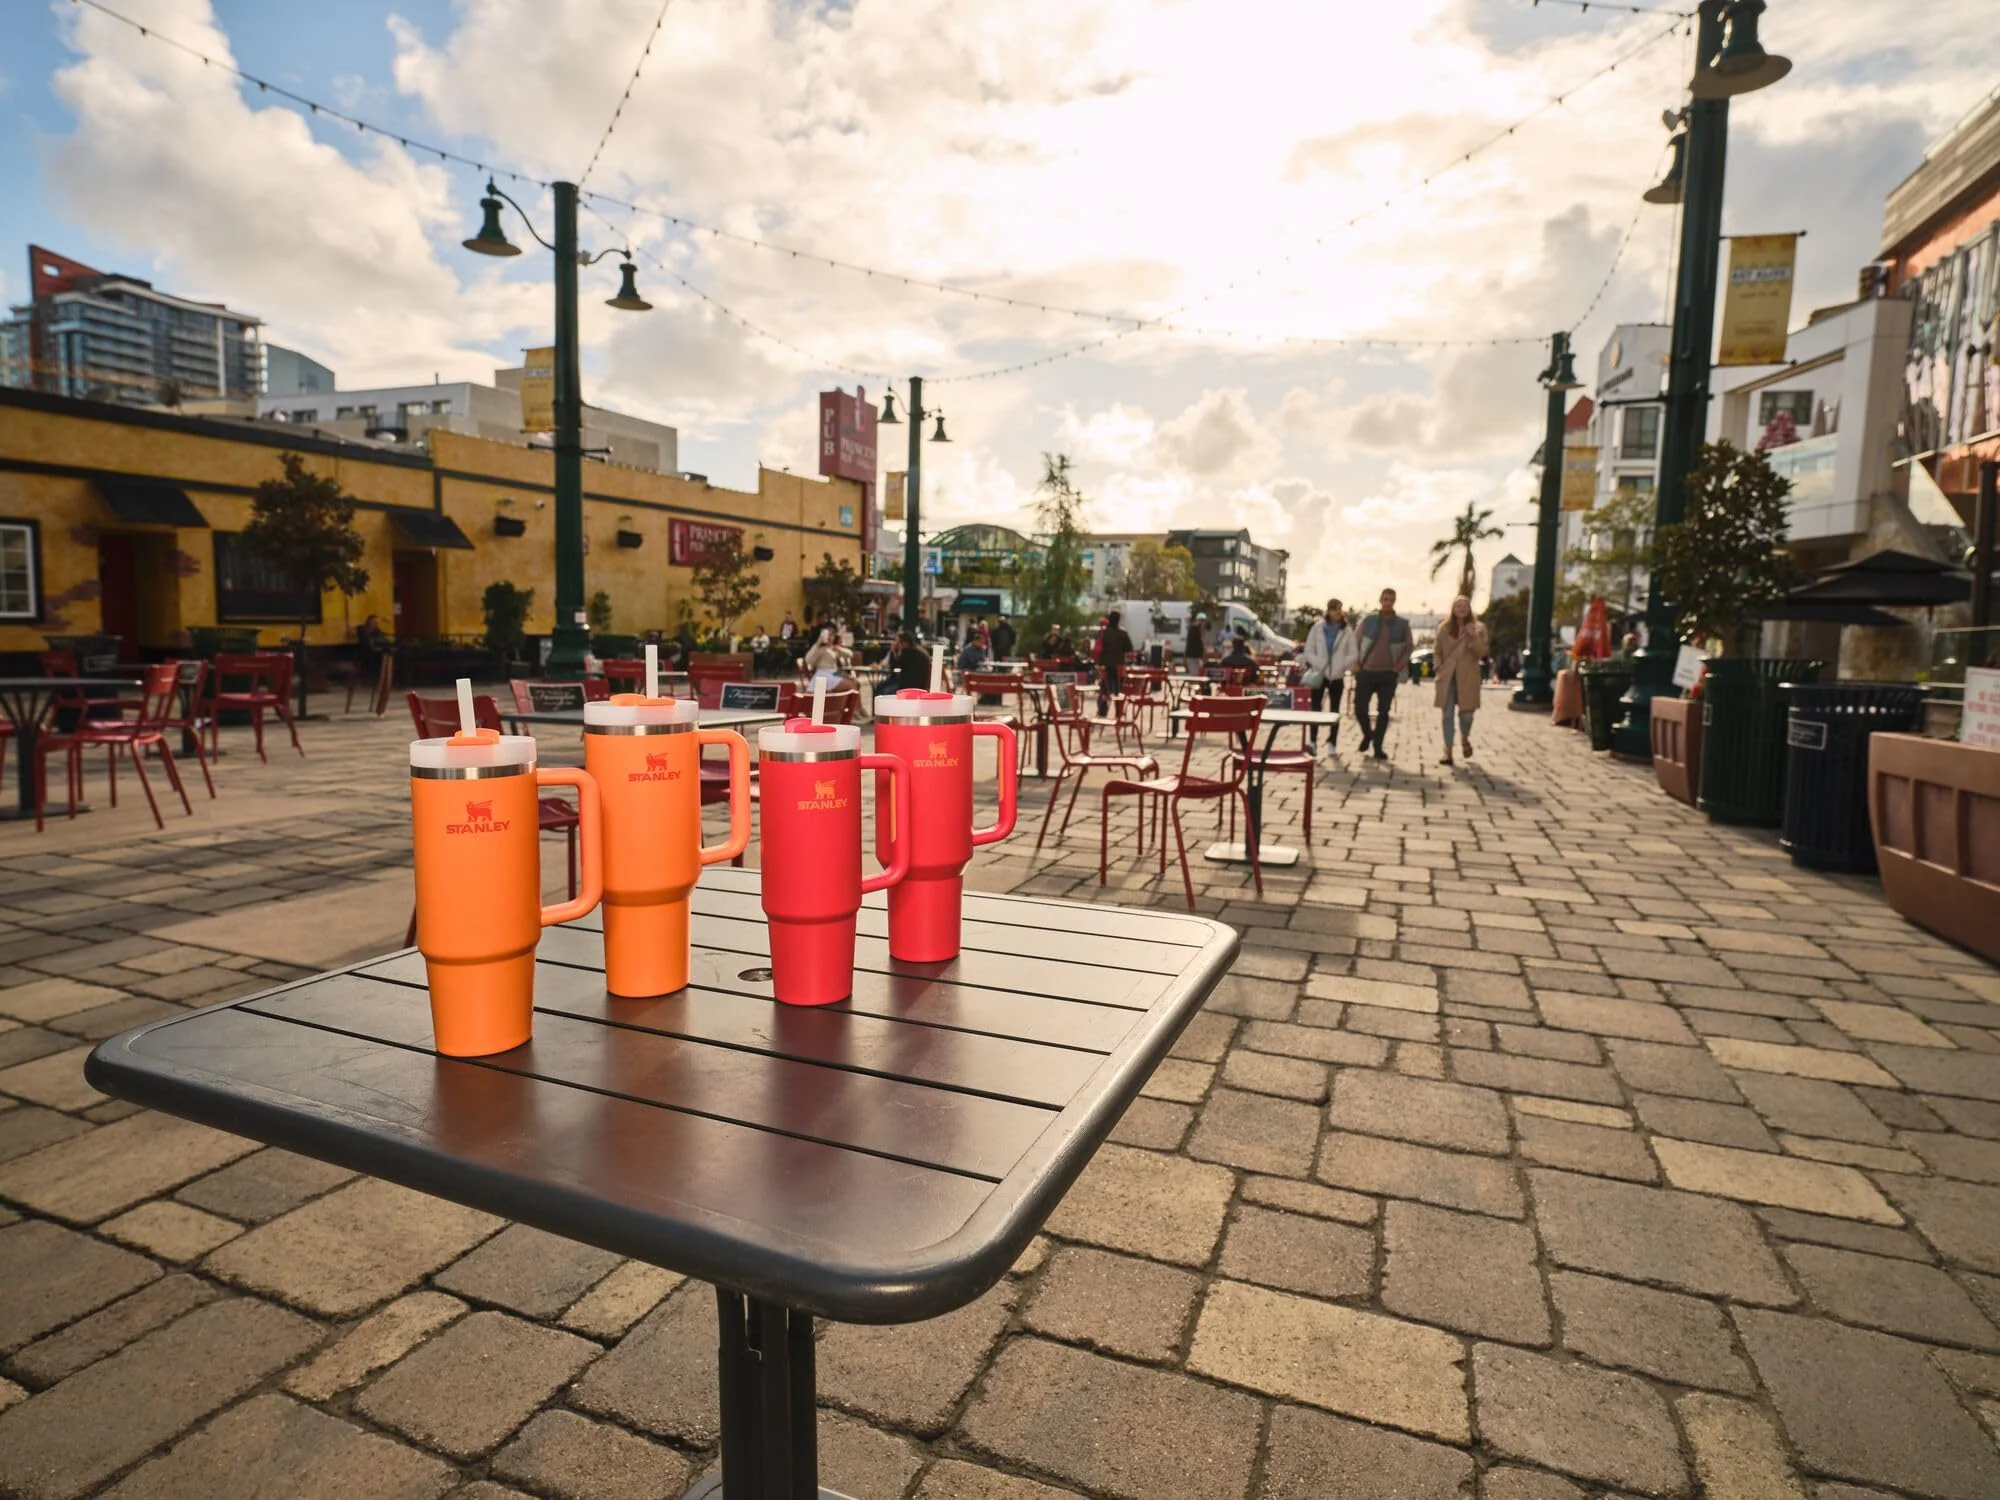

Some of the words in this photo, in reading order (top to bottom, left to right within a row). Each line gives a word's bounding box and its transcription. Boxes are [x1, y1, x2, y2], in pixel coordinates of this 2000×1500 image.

[824, 408, 835, 456] PUB
[912, 758, 960, 768] STANLEY
[627, 770, 681, 782] STANLEY
[797, 798, 848, 810] STANLEY
[446, 820, 510, 834] STANLEY
